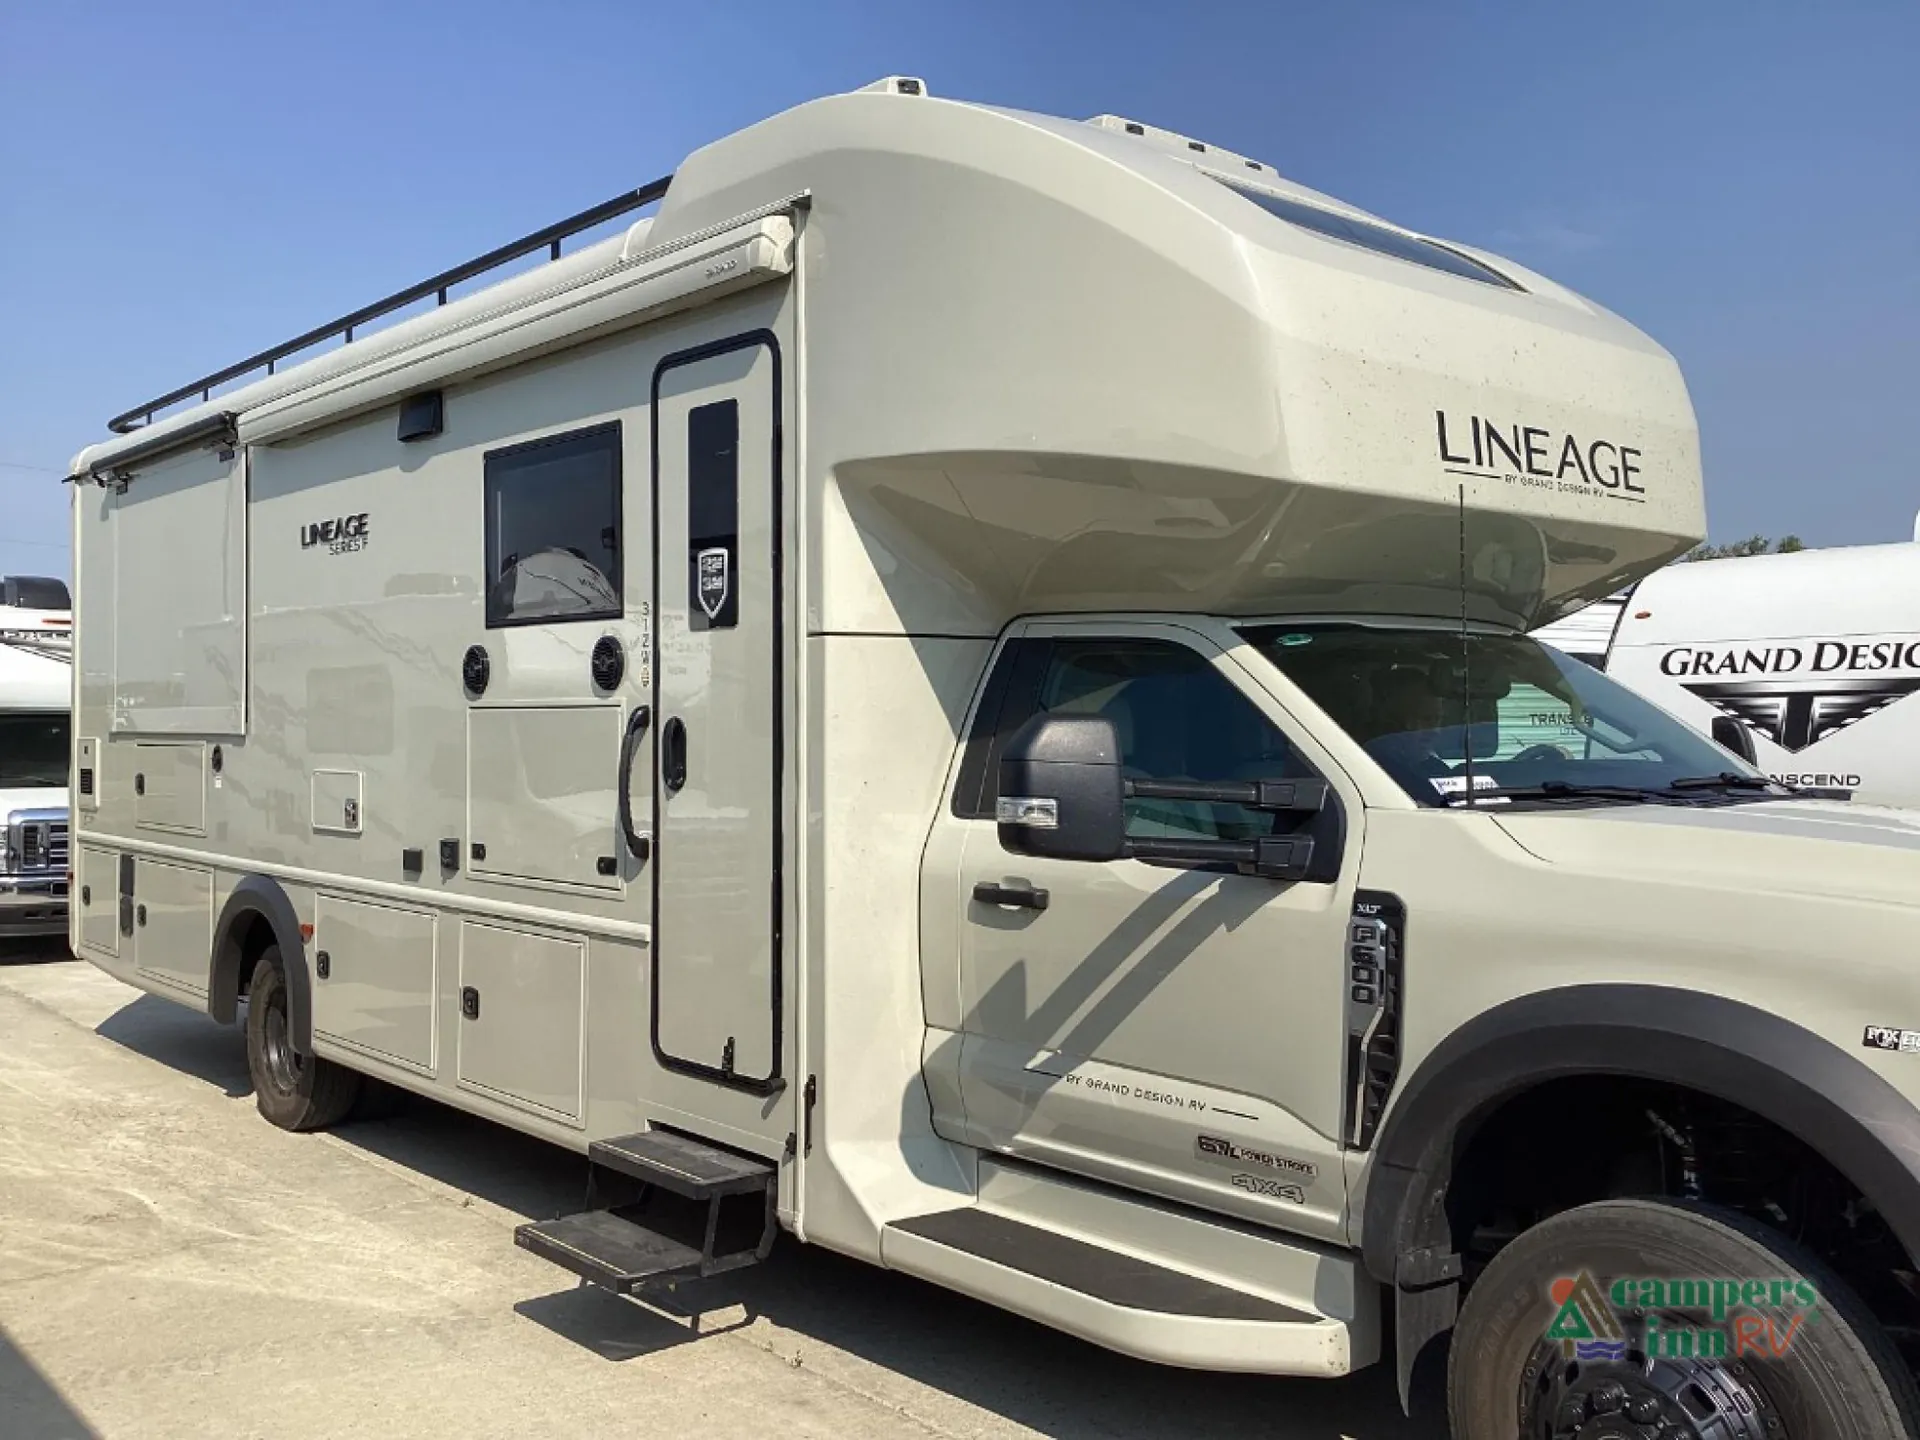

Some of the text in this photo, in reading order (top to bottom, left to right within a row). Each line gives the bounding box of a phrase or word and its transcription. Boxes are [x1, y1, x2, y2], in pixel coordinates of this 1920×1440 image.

[1435, 409, 1646, 494] LINEAGE
[1504, 474, 1517, 484] BY
[301, 512, 370, 547] LINEAGE
[1660, 647, 1802, 676] GRAND
[1356, 903, 1381, 914] XLT
[1066, 1073, 1207, 1111] BY GRAND DESIGN RV
